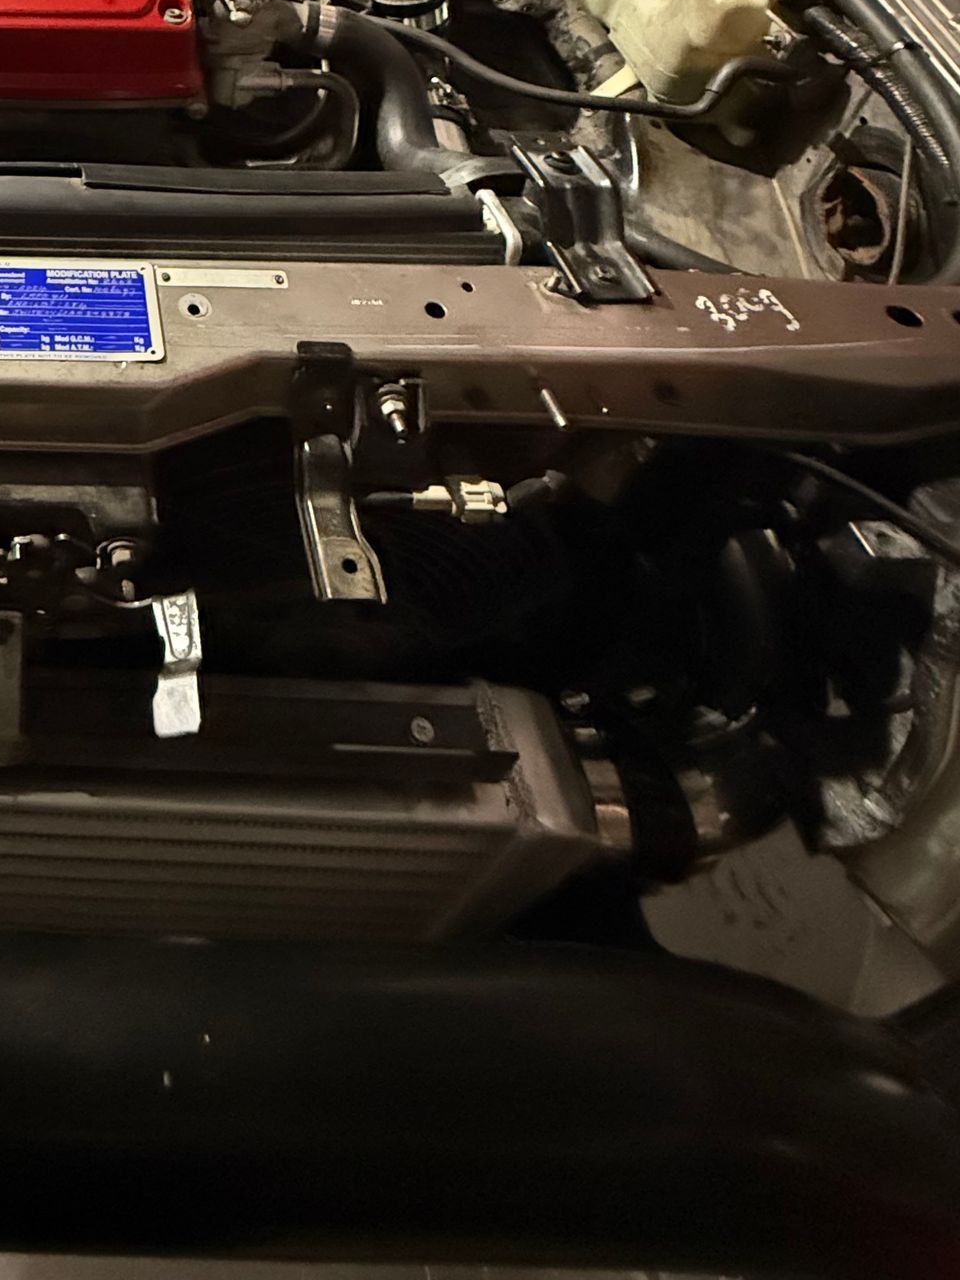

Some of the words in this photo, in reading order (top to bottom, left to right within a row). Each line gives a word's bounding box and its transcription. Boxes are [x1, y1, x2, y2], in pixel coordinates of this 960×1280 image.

[46, 270, 109, 278] MODIFICATION
[110, 271, 138, 279] PLATE
[0, 325, 30, 334] Capacity:
[54, 343, 70, 351] Mod
